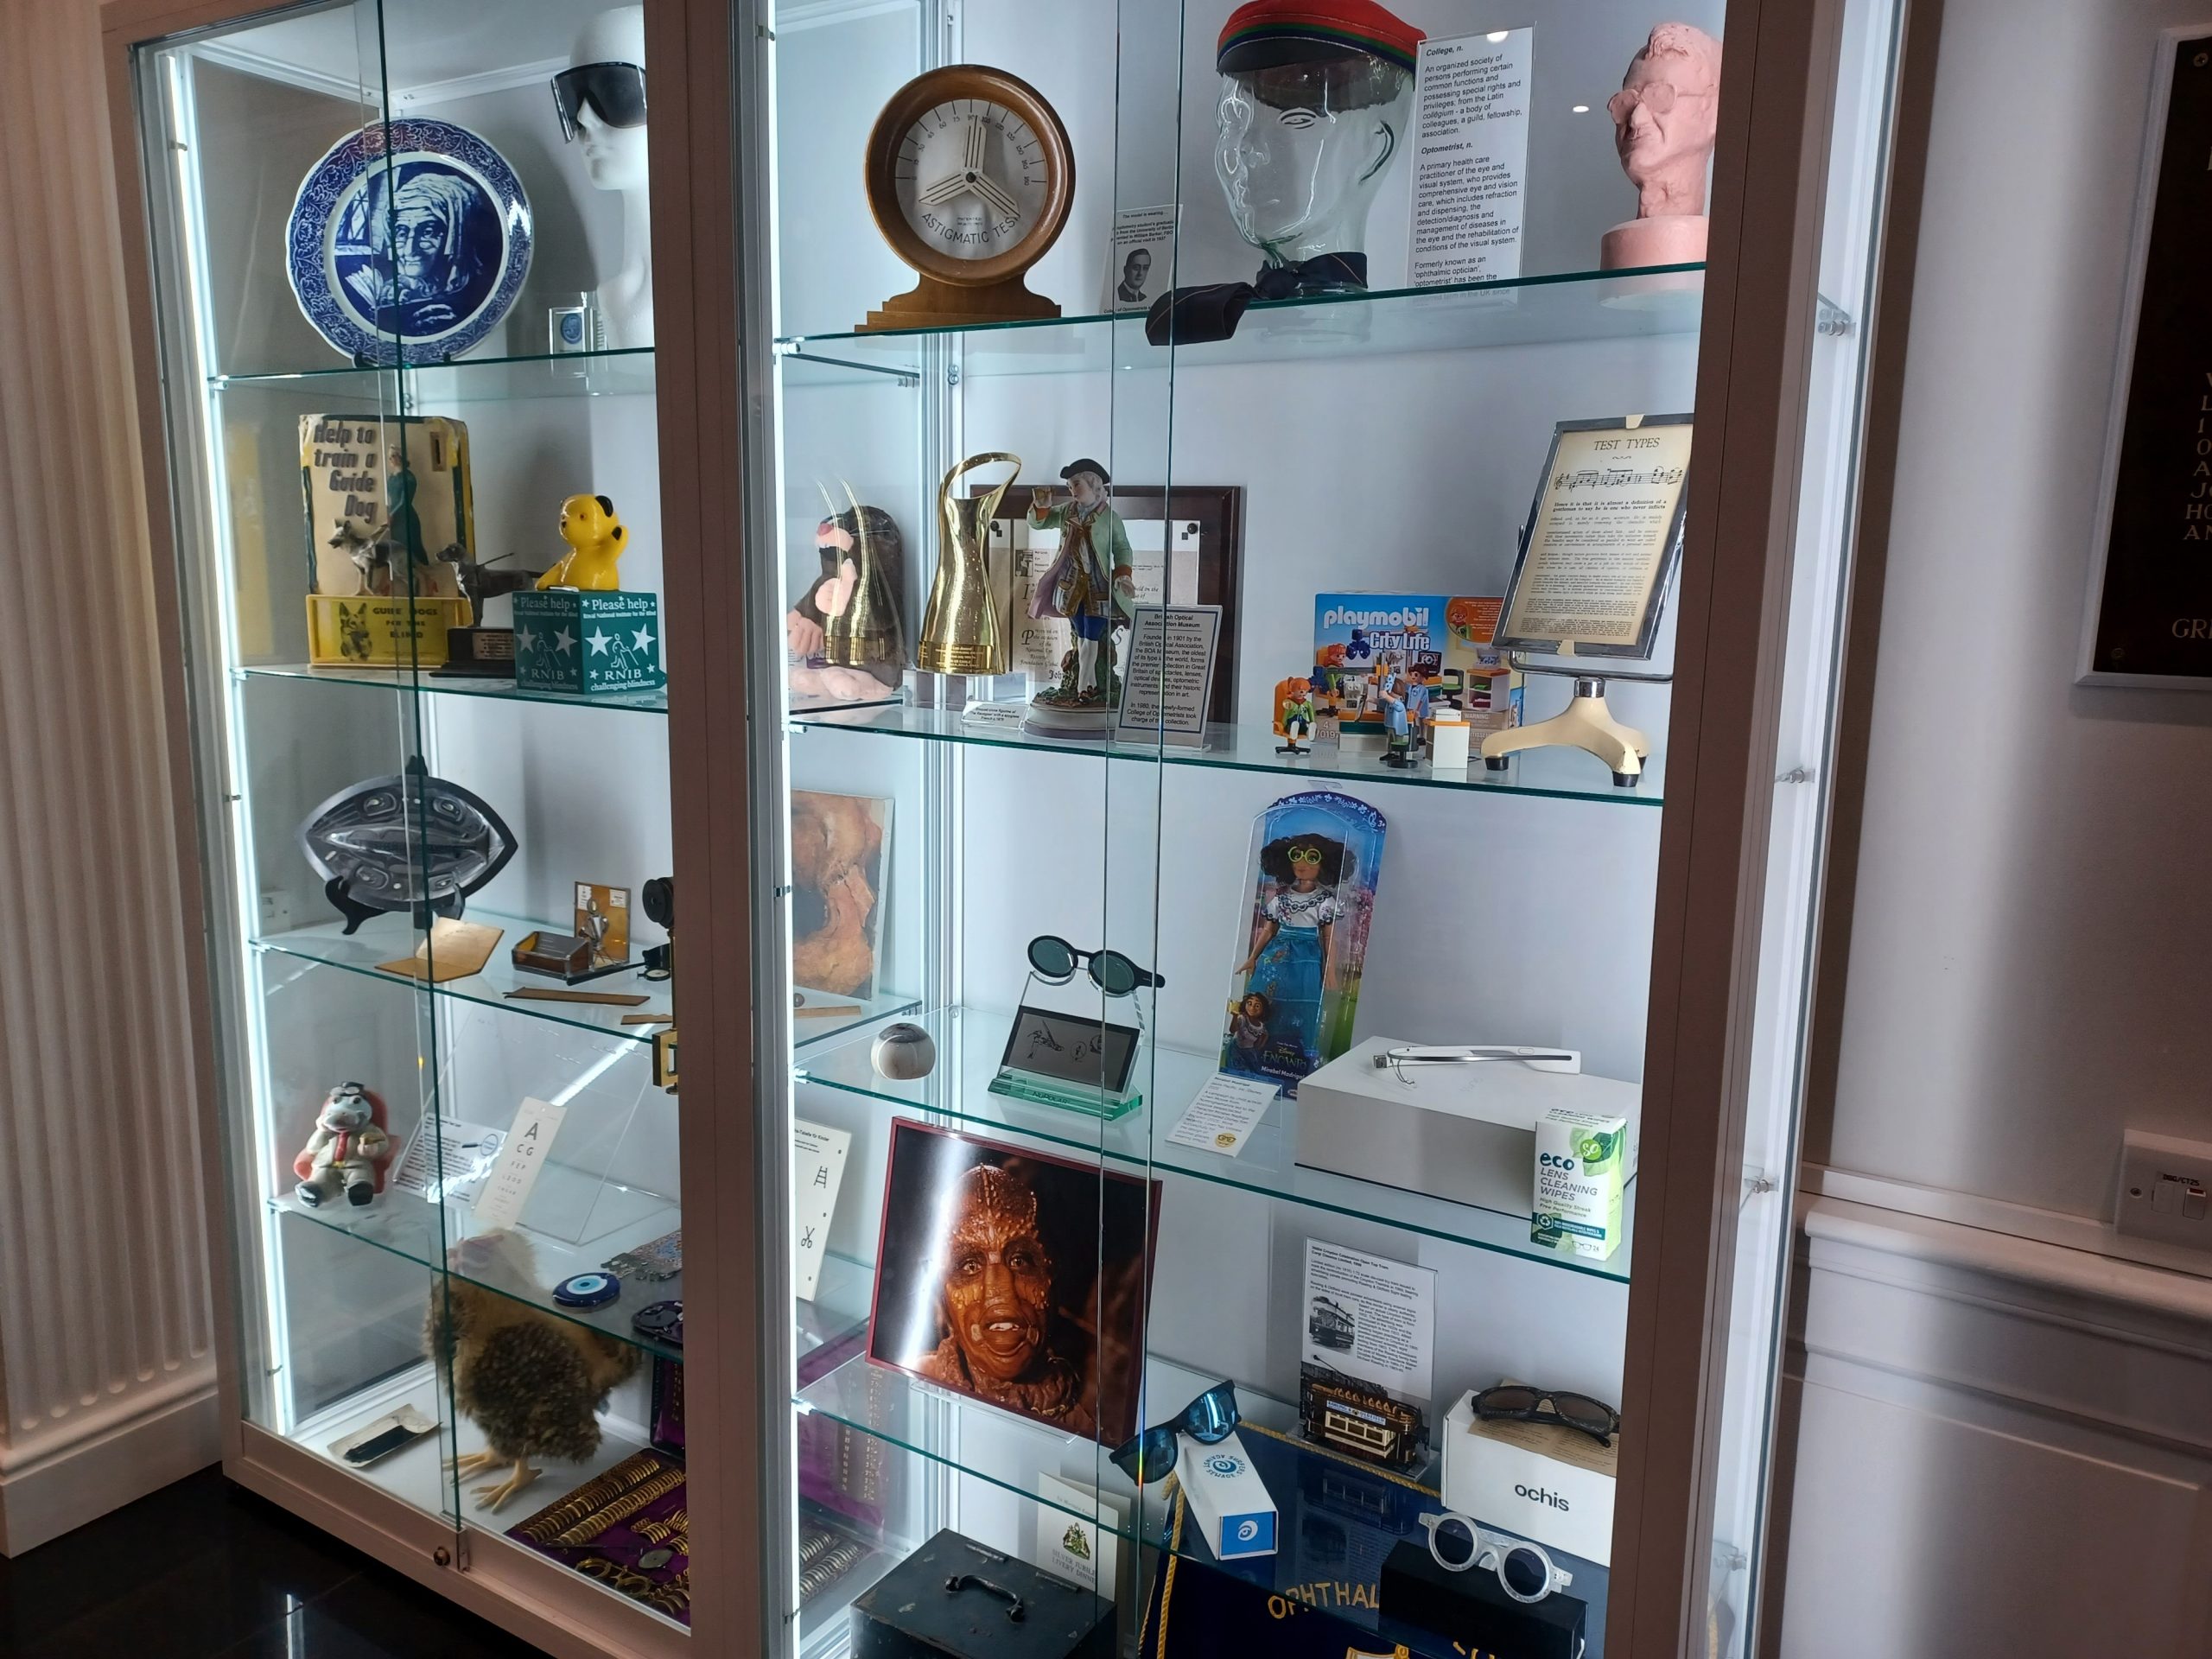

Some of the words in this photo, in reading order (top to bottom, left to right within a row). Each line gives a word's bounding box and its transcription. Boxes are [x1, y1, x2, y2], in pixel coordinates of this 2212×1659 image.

[1427, 48, 1455, 56] College,
[1436, 60, 1469, 72] organized
[1471, 57, 1494, 66] society
[1425, 73, 1451, 84] persons
[1452, 67, 1488, 79] performing
[1490, 63, 1513, 72] certain
[1424, 82, 1452, 92] common
[1454, 78, 1484, 86] functions
[1485, 73, 1498, 82] and
[1424, 91, 1460, 102] possessing
[1462, 86, 1485, 96] special
[1487, 83, 1506, 92] rights
[1508, 79, 1521, 88] and
[1422, 119, 1459, 129] colleagues,
[1467, 114, 1484, 124] guild,
[1487, 110, 1522, 119] fellowship,
[1422, 128, 1459, 138] association.
[1421, 143, 1464, 155] Optometrist,
[1427, 162, 1452, 171] primary
[1420, 170, 1456, 181] practitioner
[1419, 188, 1468, 198] comprehensive
[1457, 194, 1484, 203] includes
[921, 213, 989, 245] ASTIGMATIC
[1417, 225, 1459, 234] management
[1468, 229, 1510, 238] rehabilitation
[1415, 245, 1448, 253] conditions
[1491, 238, 1516, 246] system.
[313, 420, 352, 448] Help
[357, 427, 374, 444] to
[1594, 440, 1621, 450] TEST
[1626, 438, 1660, 448] TYPES
[314, 448, 358, 467] train
[365, 454, 376, 467] a
[329, 470, 374, 493] Guide
[344, 494, 377, 524] Dog
[520, 597, 548, 609] Please
[550, 597, 570, 612] help
[592, 598, 625, 611] Please
[627, 597, 649, 611] help
[1323, 606, 1429, 630] playmobil
[1369, 631, 1402, 650] City
[1402, 632, 1431, 650] Life
[531, 668, 564, 680] RNIB
[605, 668, 642, 680] RNIB
[591, 682, 627, 691] challenging
[1261, 1065, 1281, 1076] Mirabel
[524, 1122, 538, 1141] A
[517, 1144, 524, 1153] C
[526, 1147, 534, 1156] G
[1540, 1152, 1575, 1171] eco
[1540, 1167, 1569, 1180] LENS
[1540, 1177, 1599, 1196] CLEANING
[1541, 1186, 1576, 1201] WIPES
[1515, 1484, 1570, 1512] ochis
[1077, 1569, 1096, 1584] DINNE
